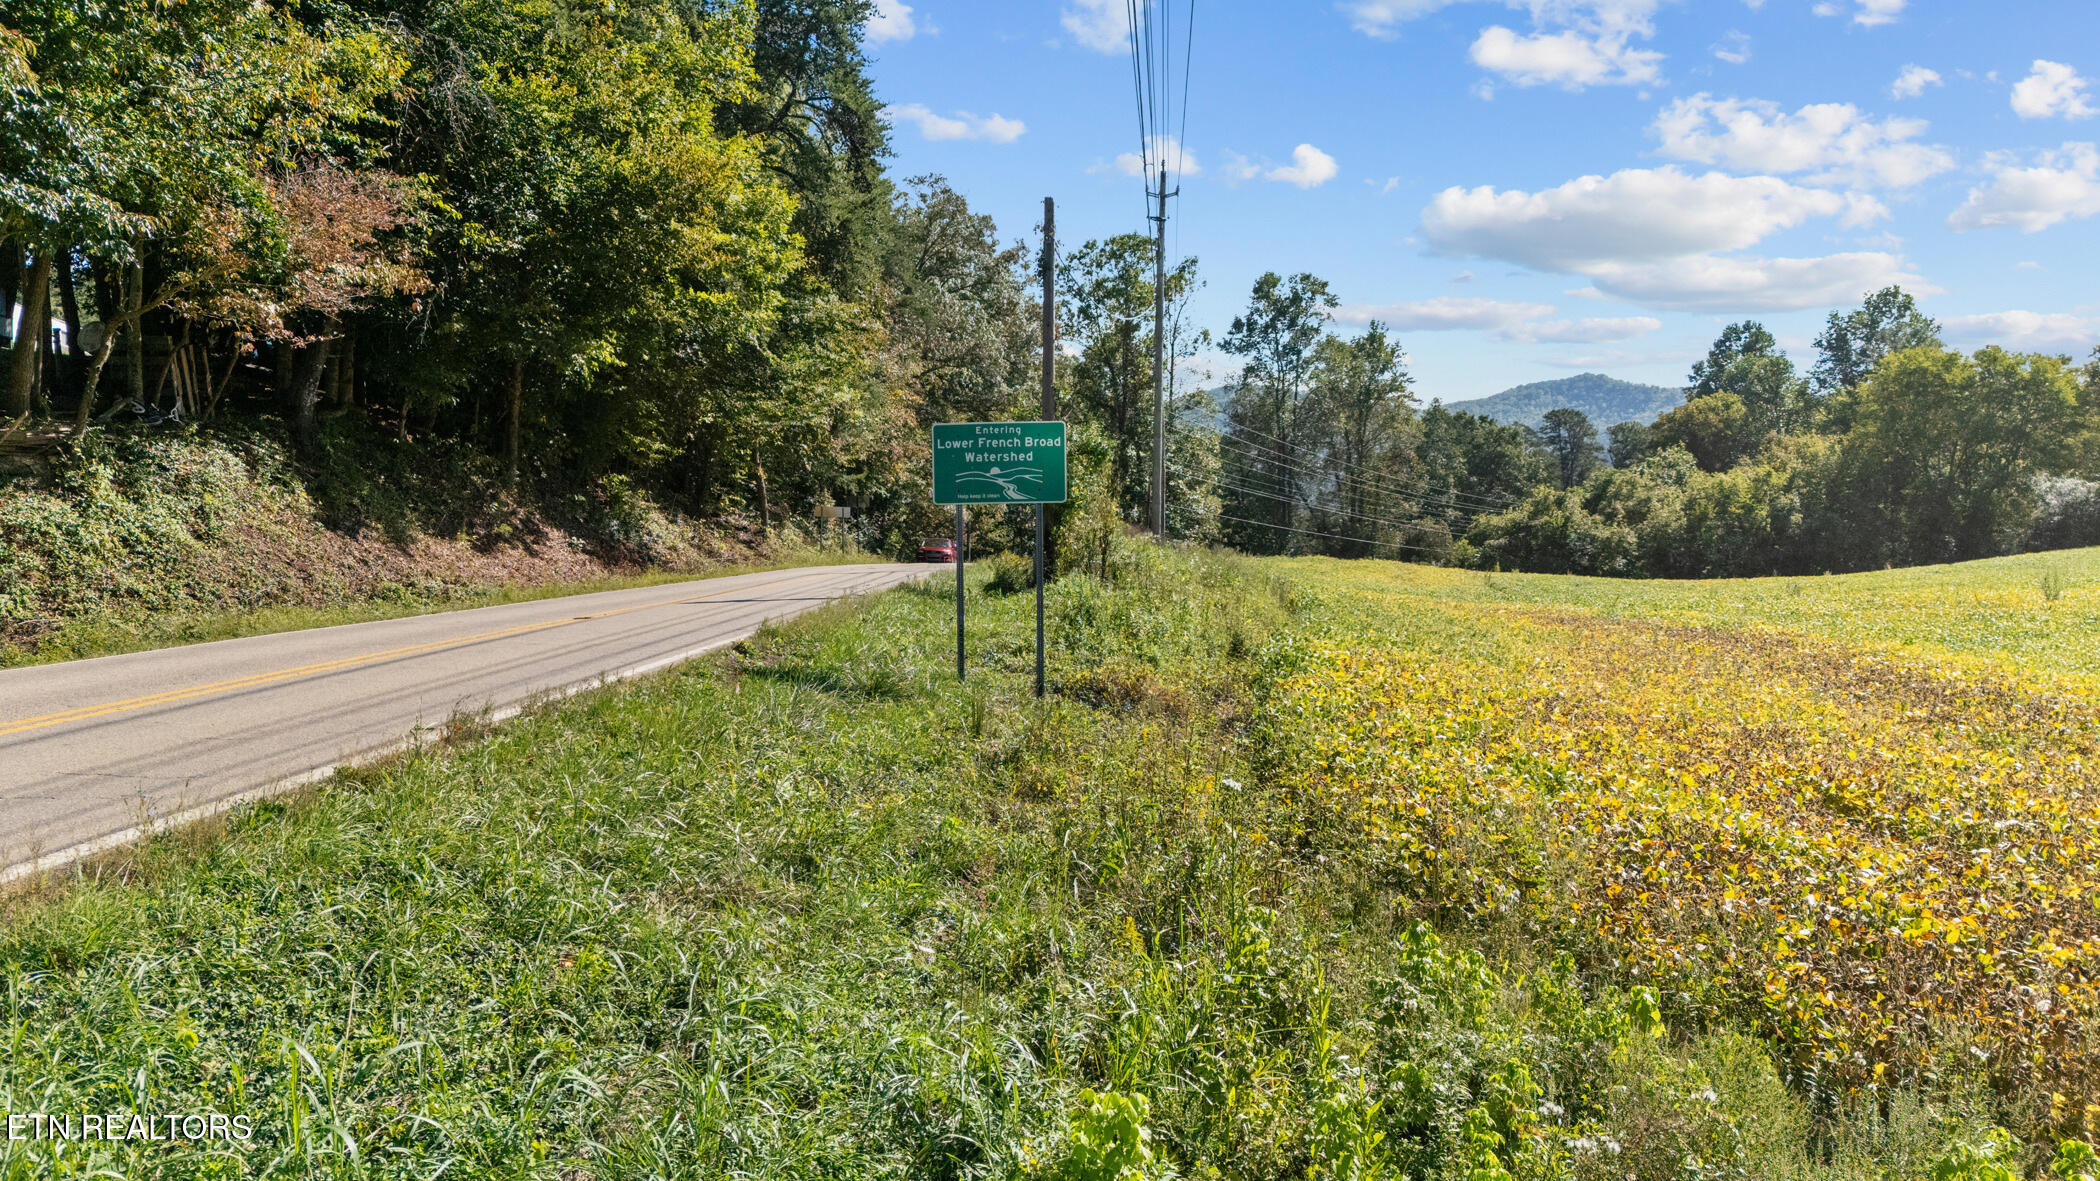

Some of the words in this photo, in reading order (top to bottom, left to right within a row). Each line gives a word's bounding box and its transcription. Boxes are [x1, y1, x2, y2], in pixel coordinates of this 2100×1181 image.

[975, 426, 1021, 435] Entering
[937, 439, 974, 449] Lower
[978, 437, 1021, 447] French
[1024, 436, 1061, 447] Broad
[965, 451, 1033, 462] Watershed
